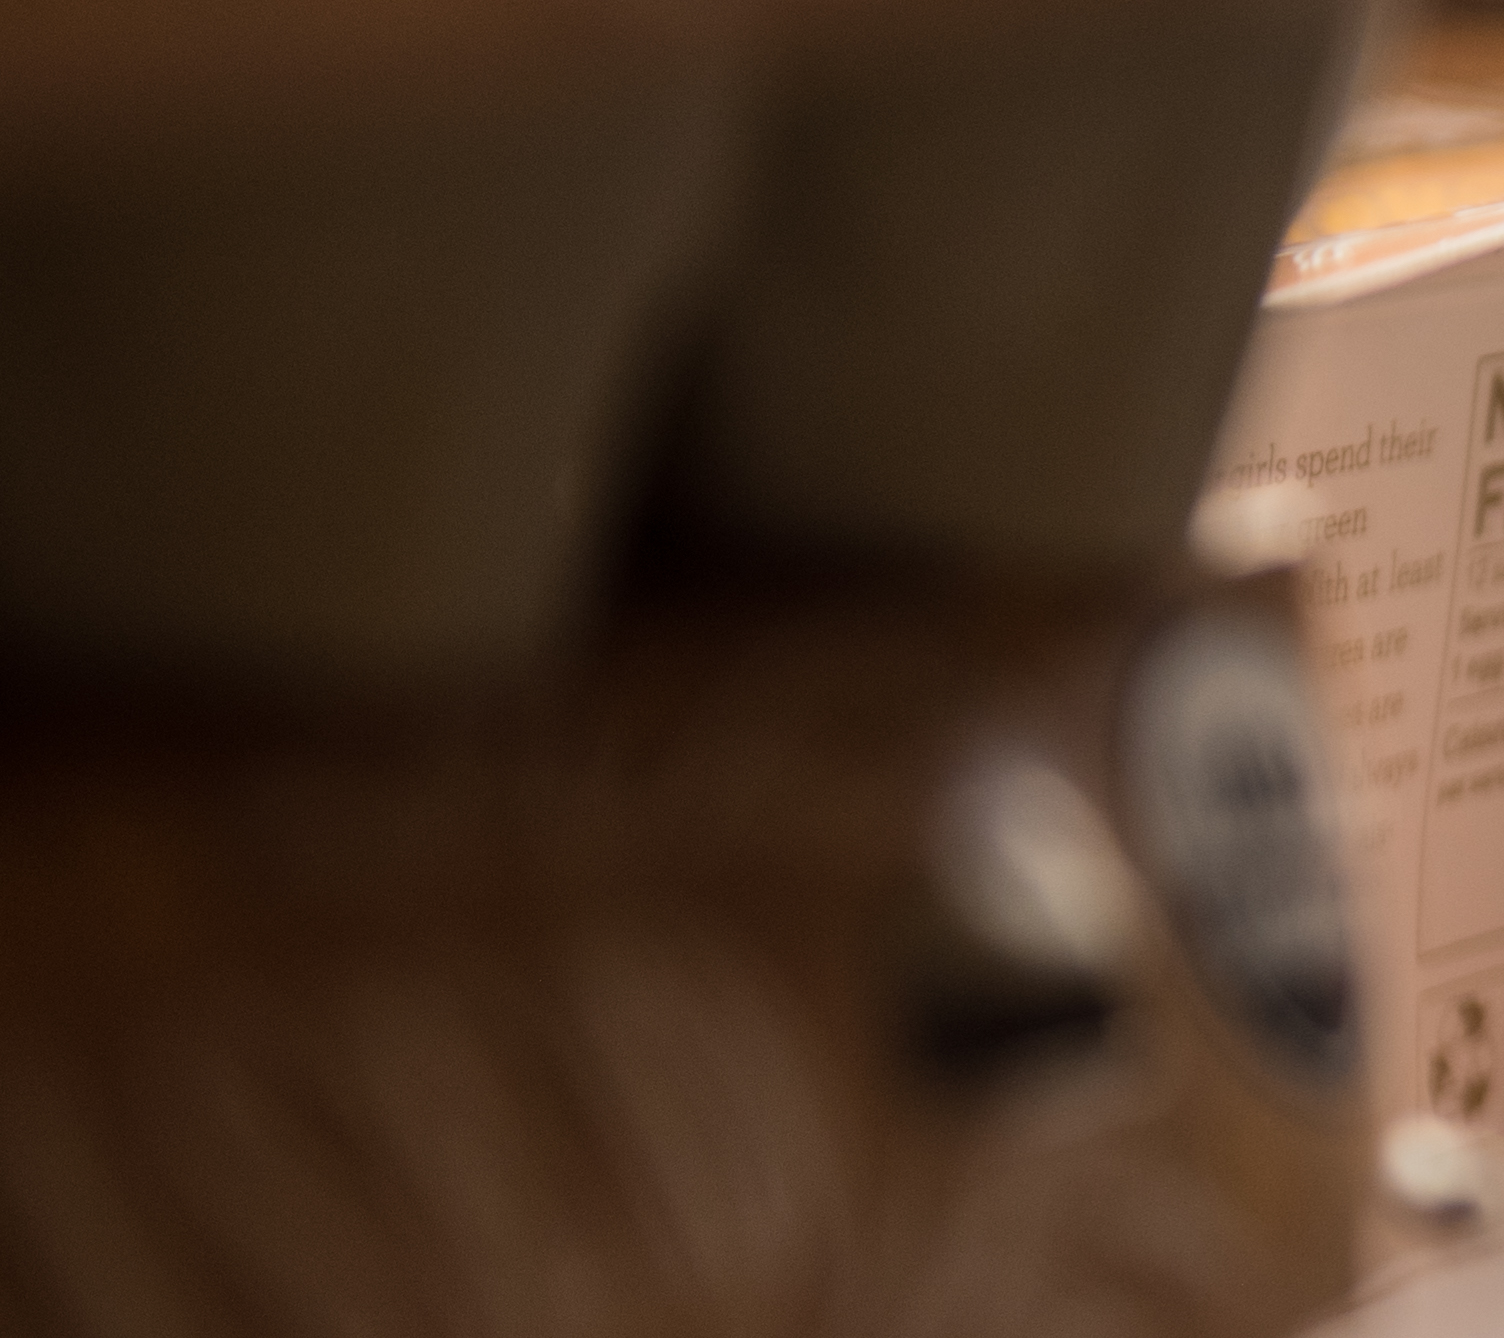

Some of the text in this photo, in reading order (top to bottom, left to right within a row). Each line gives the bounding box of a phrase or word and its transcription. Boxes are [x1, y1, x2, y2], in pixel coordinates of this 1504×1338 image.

[1296, 421, 1373, 488] spend
[1380, 418, 1438, 463] their
[1300, 507, 1368, 546] reen
[1356, 566, 1379, 603] at
